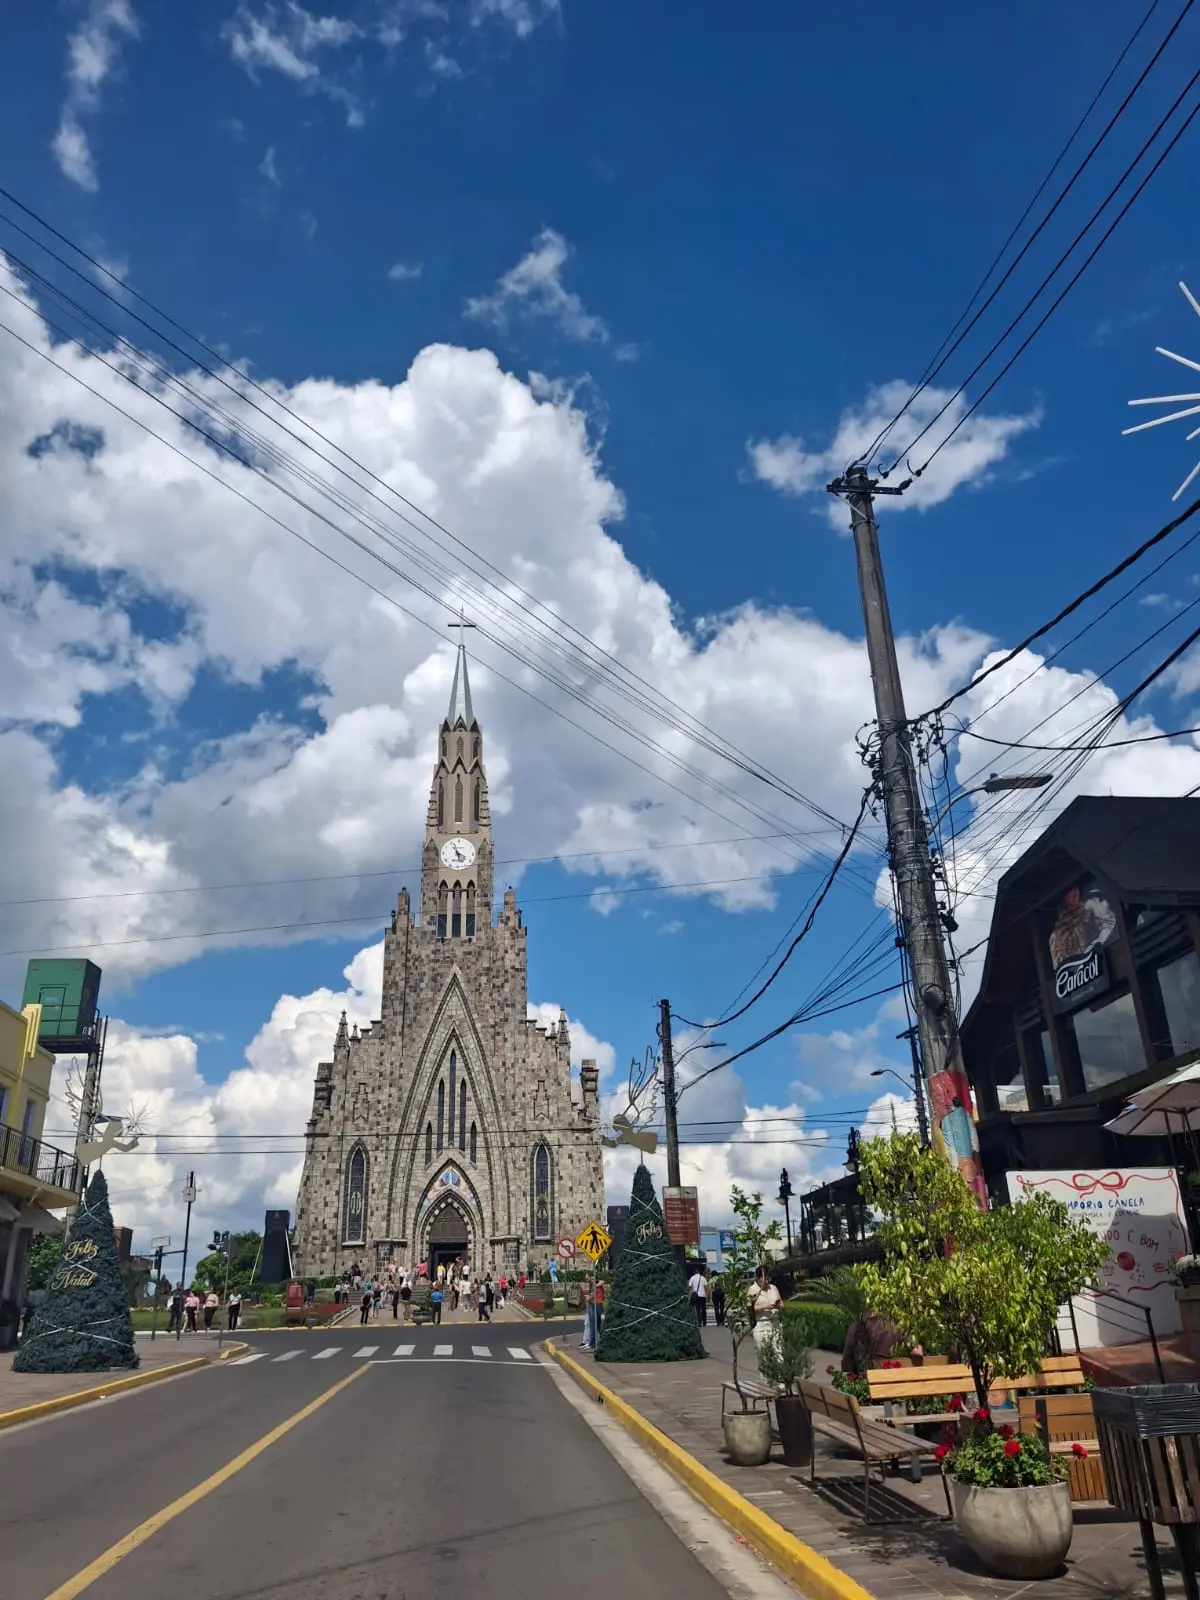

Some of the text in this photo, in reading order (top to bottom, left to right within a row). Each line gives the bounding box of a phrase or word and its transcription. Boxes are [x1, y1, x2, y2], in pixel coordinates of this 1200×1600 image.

[1056, 951, 1099, 999] Caracol
[1066, 1197, 1145, 1209] MPORIO CANELA
[636, 1220, 663, 1246] Feliz
[63, 1238, 99, 1261] Feliz
[51, 1265, 97, 1290] Natal
